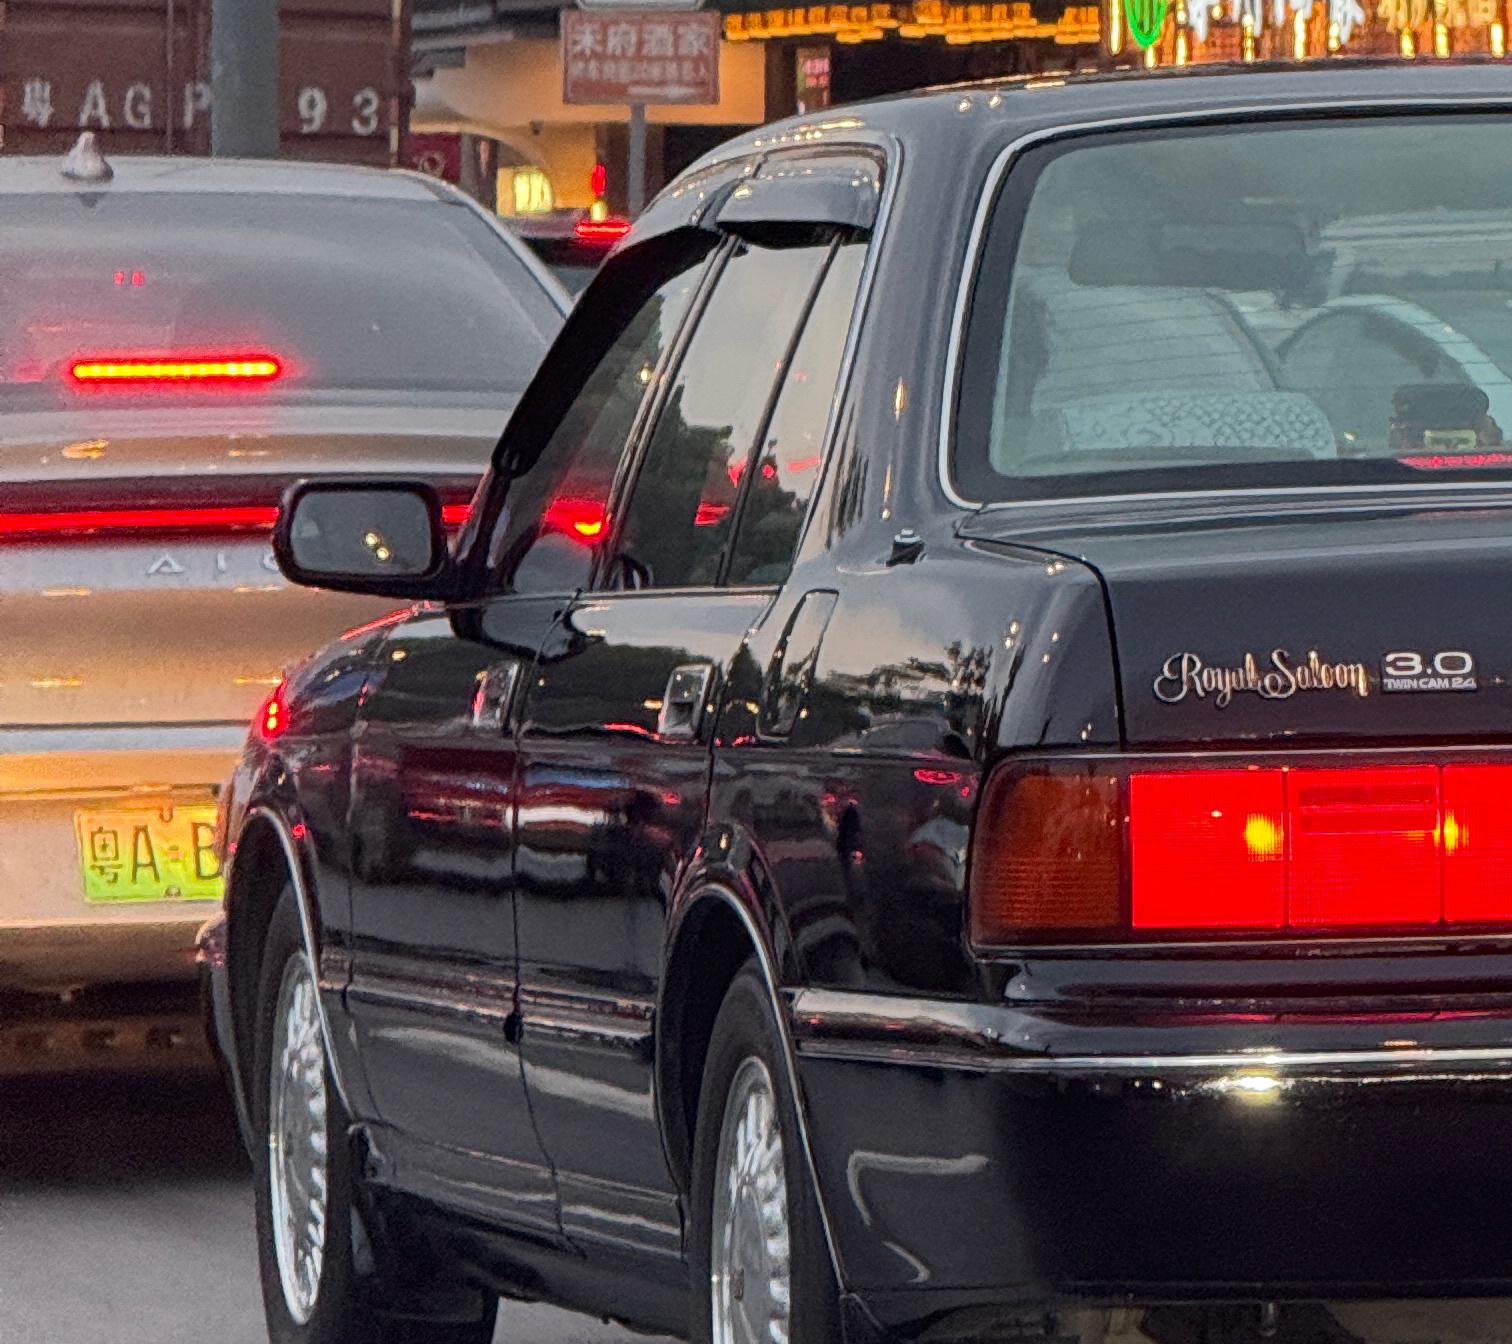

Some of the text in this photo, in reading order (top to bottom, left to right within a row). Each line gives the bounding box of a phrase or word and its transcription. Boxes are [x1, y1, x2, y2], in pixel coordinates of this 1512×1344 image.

[1384, 650, 1474, 675] 3.0
[1153, 648, 1369, 709] Royal Saloon
[1384, 677, 1418, 691] TWIN
[1418, 677, 1450, 690] CAM
